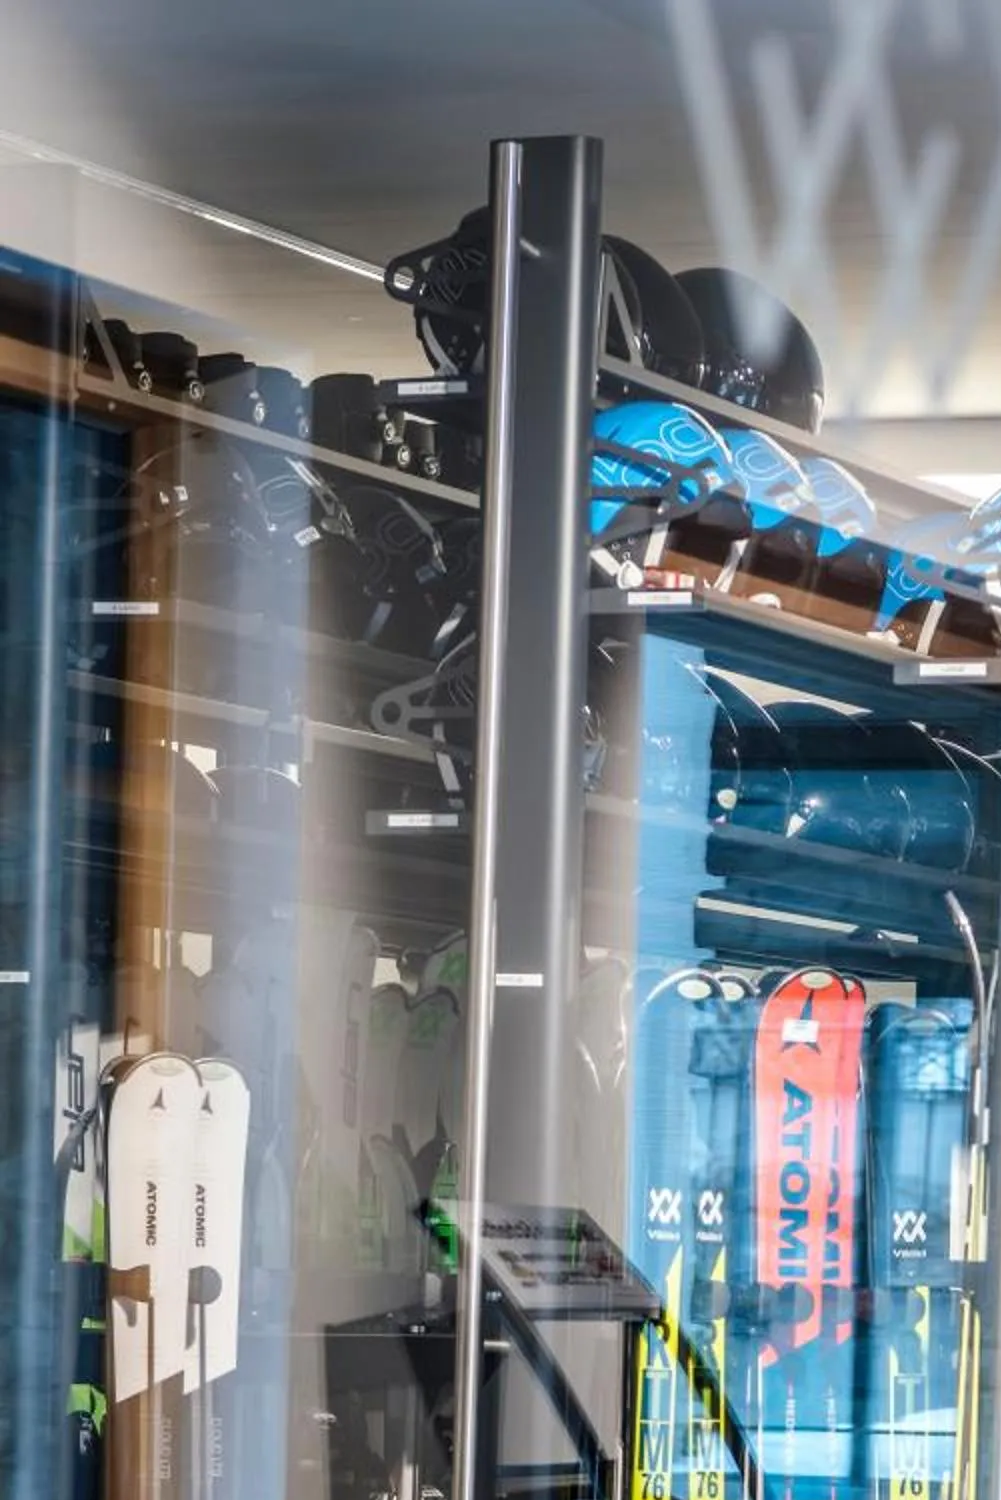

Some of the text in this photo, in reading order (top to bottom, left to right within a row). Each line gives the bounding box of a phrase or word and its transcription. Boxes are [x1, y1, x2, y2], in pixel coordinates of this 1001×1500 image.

[776, 1078, 813, 1280] ATOMI
[145, 1180, 157, 1247] ATOMIC
[194, 1183, 206, 1248] ATOMIC
[696, 1471, 719, 1499] 76
[898, 1470, 923, 1496] 76
